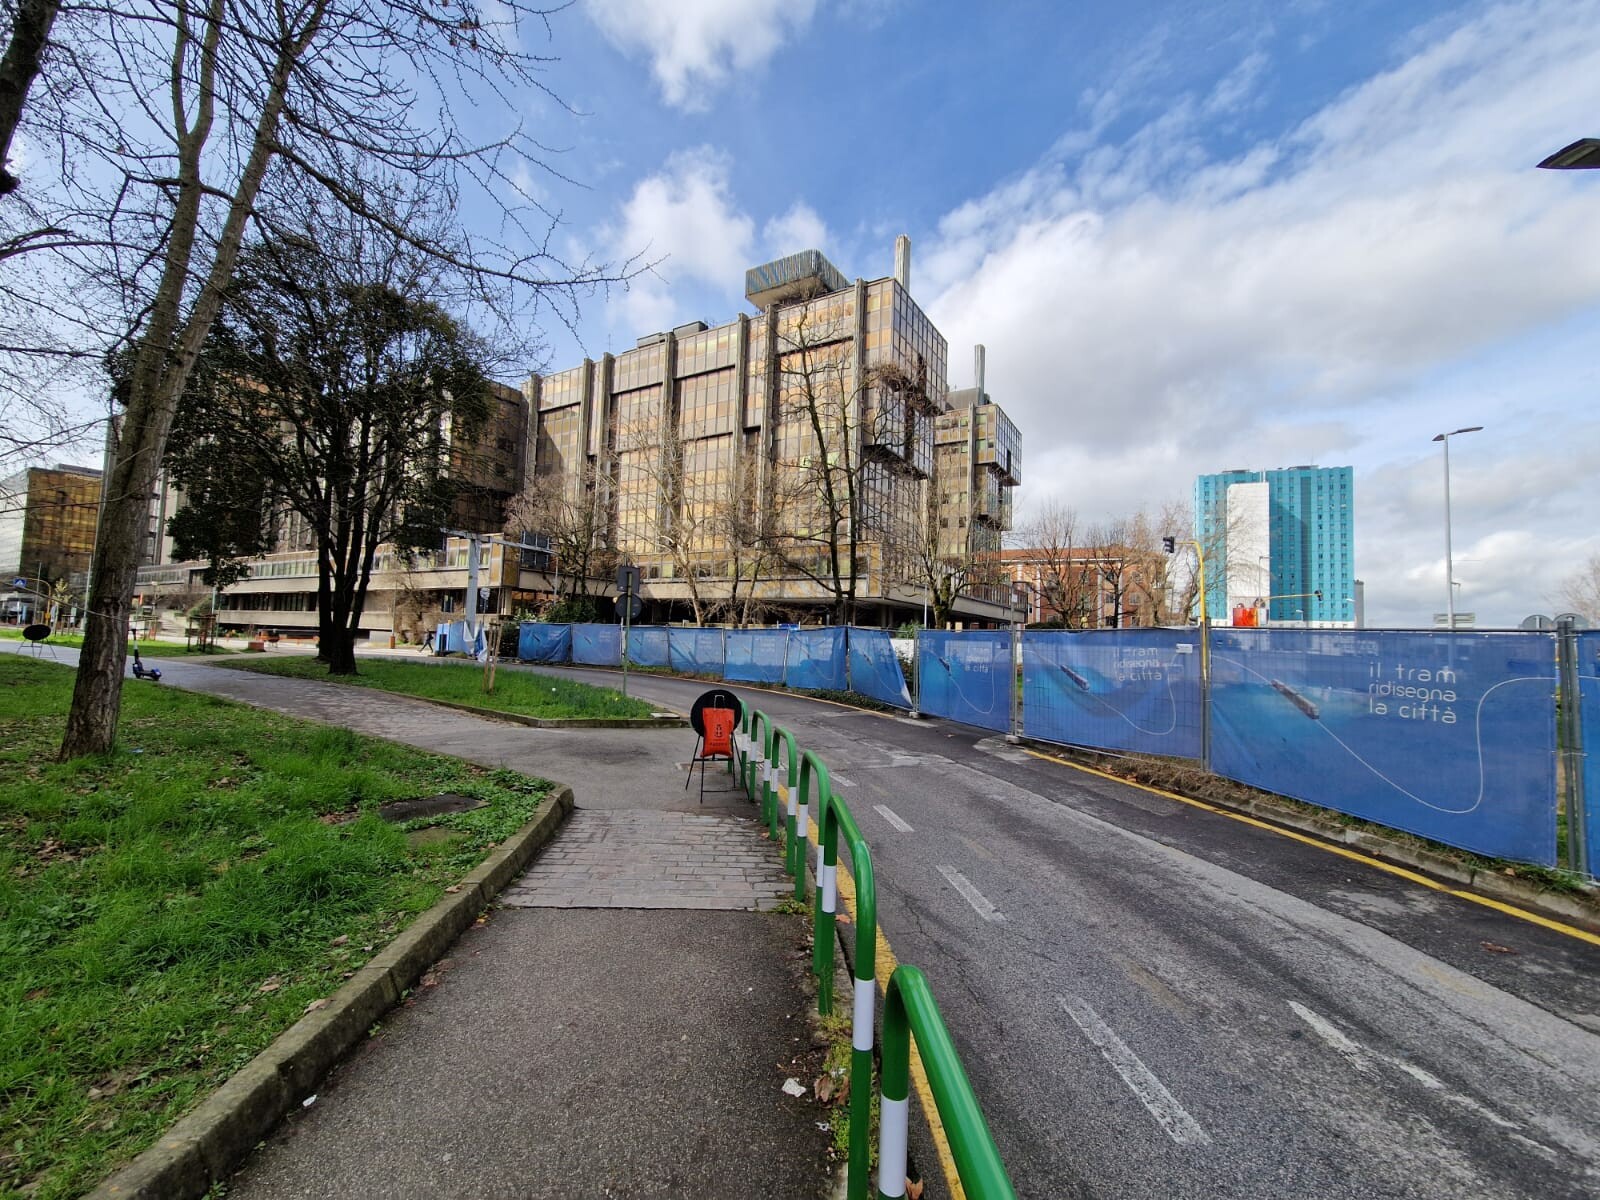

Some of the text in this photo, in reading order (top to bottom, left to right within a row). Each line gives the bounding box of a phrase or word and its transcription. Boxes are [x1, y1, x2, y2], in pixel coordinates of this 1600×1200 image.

[1369, 661, 1456, 684] il tram
[1368, 679, 1457, 703] ridisegna
[1369, 696, 1457, 724] la città
